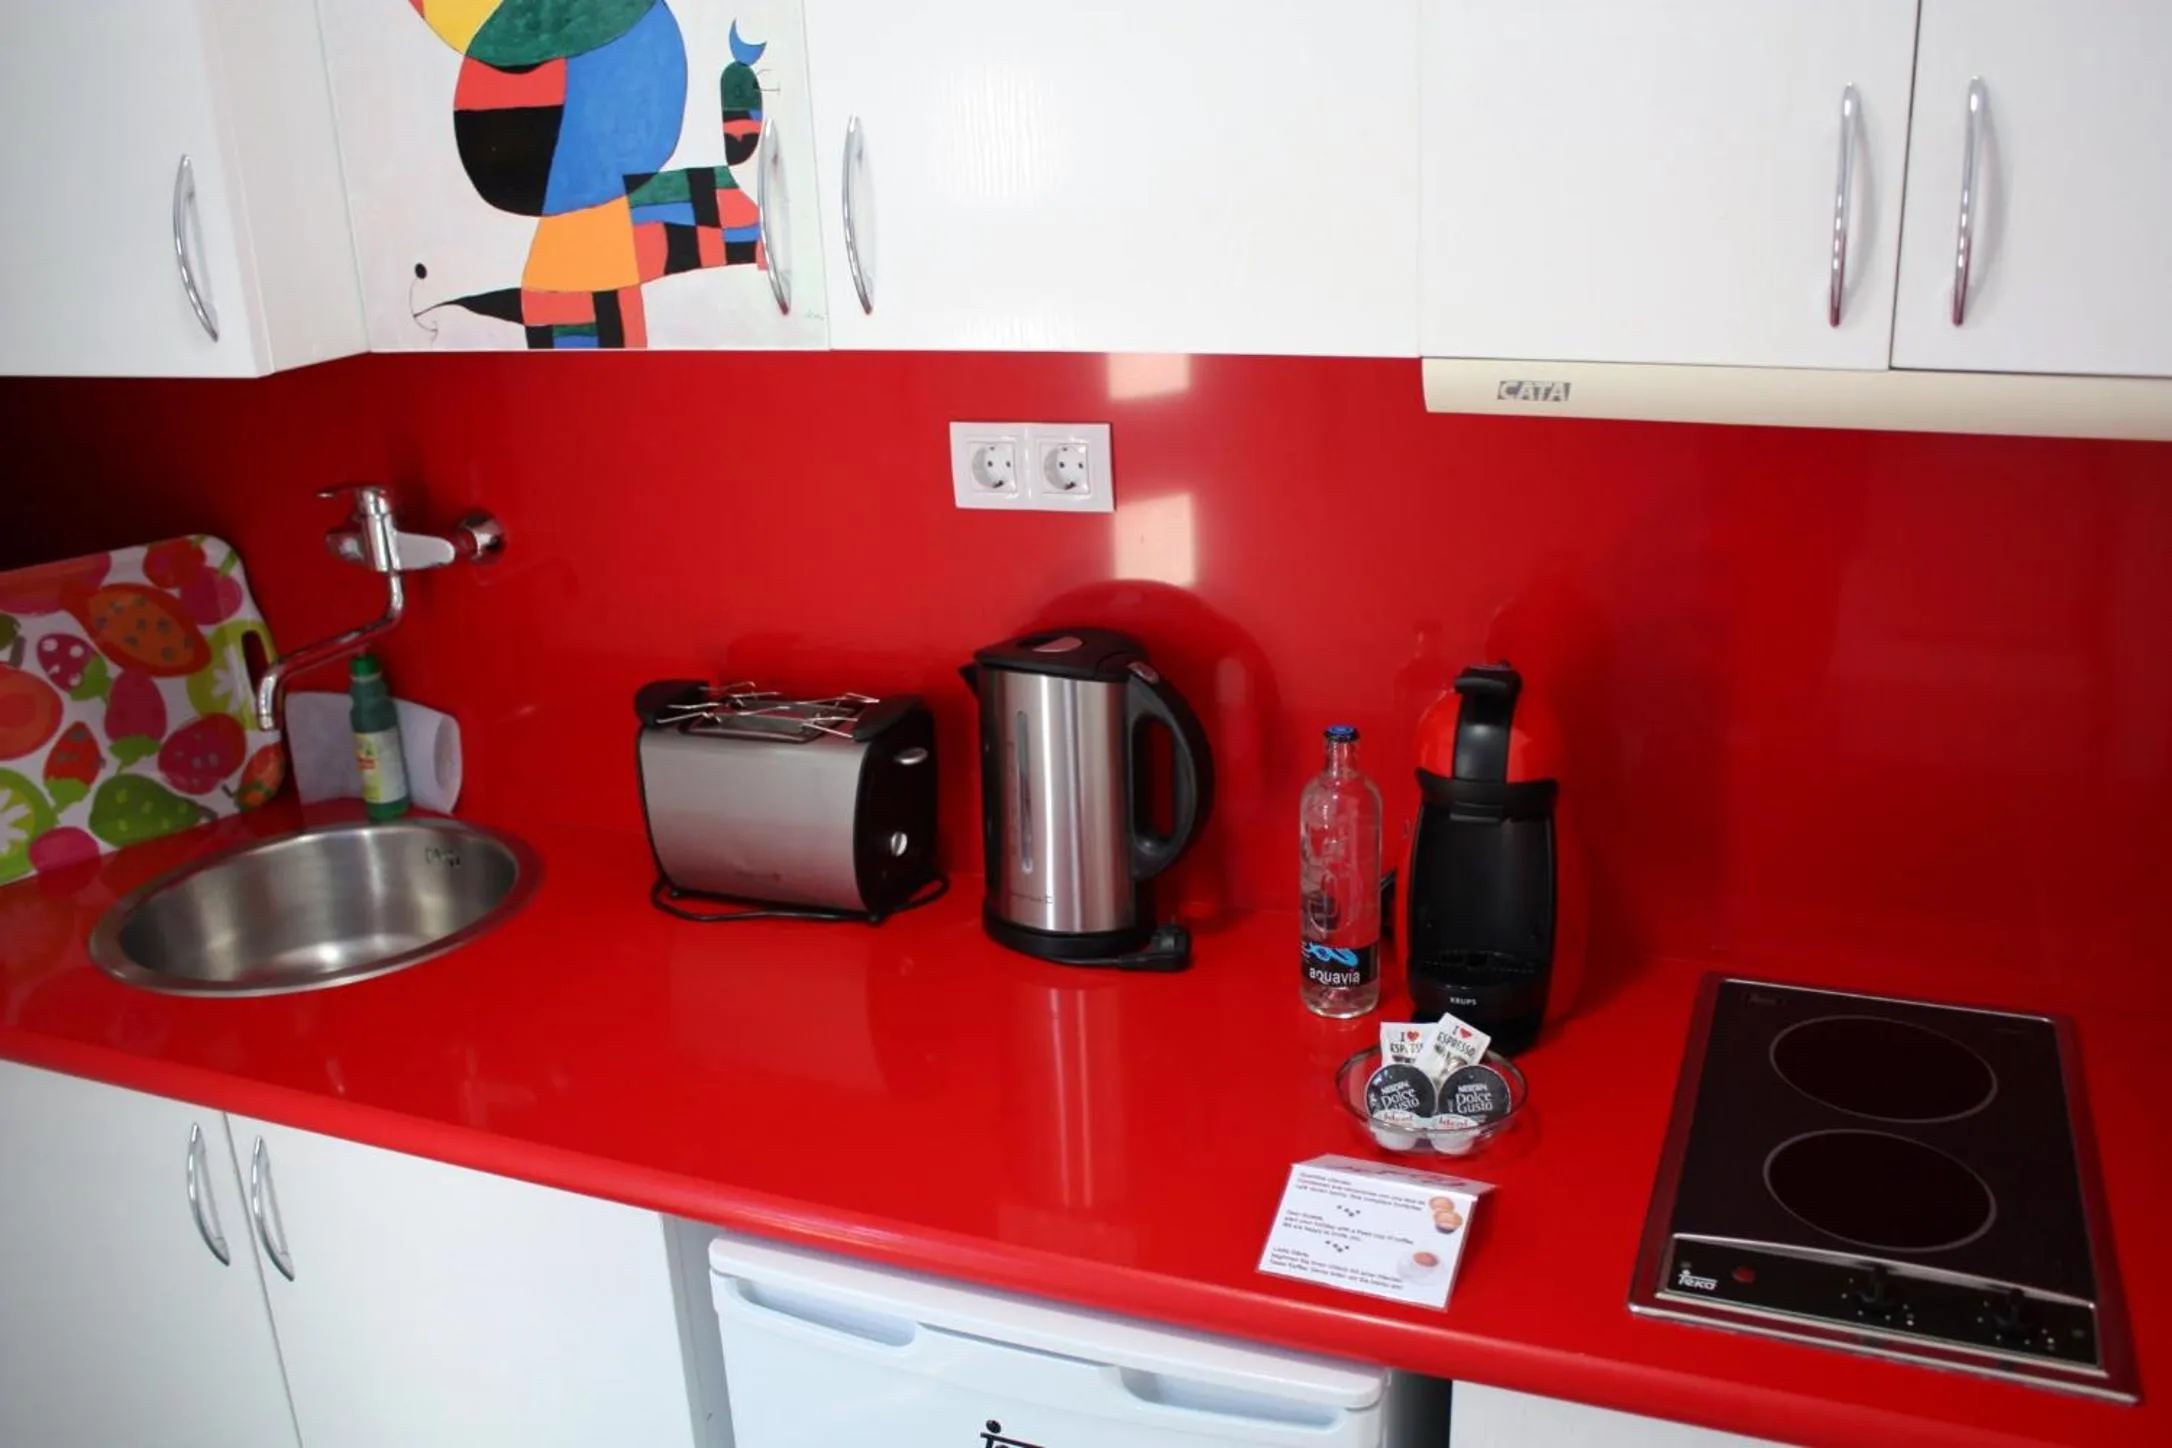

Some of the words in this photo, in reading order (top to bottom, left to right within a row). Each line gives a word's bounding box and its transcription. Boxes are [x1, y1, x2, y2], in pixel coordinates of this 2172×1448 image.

[1497, 380, 1571, 402] CATA
[1309, 967, 1361, 986] aquavia
[1449, 996, 1477, 1006] KRUPS
[1437, 1031, 1476, 1057] ESPRESSO
[1380, 1087, 1417, 1108] Dolce
[1455, 1091, 1492, 1105] Dolce
[1457, 1100, 1494, 1114] Gusto
